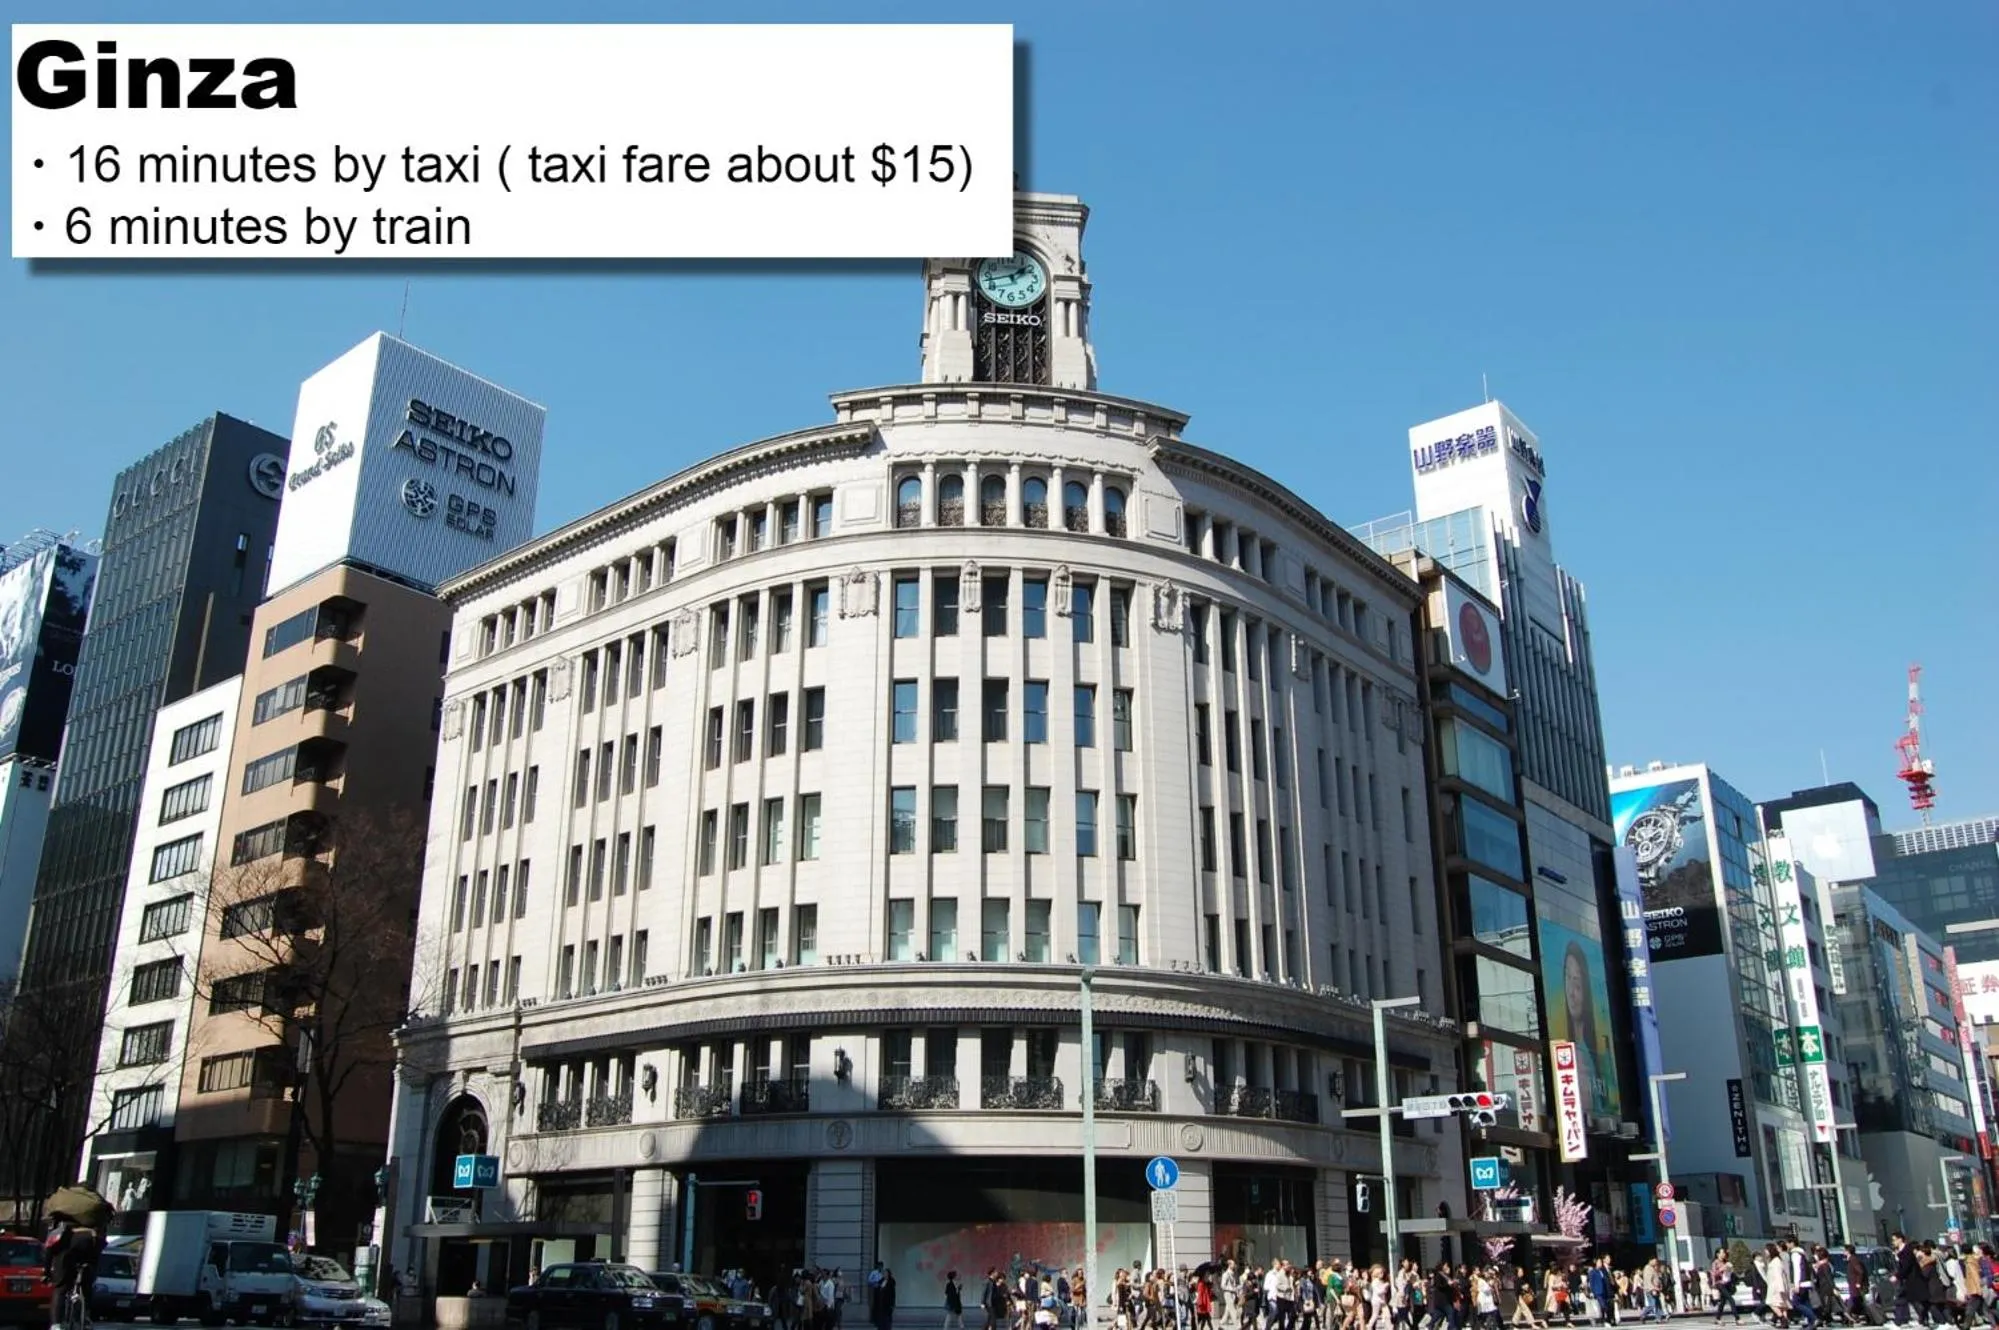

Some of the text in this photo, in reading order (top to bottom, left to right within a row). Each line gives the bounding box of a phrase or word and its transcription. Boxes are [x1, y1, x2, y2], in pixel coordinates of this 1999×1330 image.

[983, 312, 1041, 326] SEIKO
[407, 399, 513, 461] SEIKO
[392, 429, 516, 498] ASTRON
[447, 493, 498, 527] GPS
[1646, 917, 1688, 932] STRON
[1800, 1031, 1819, 1057] 本
[1561, 1074, 1580, 1152] キムラヤのパン
[1731, 1092, 1747, 1143] ZENITH
